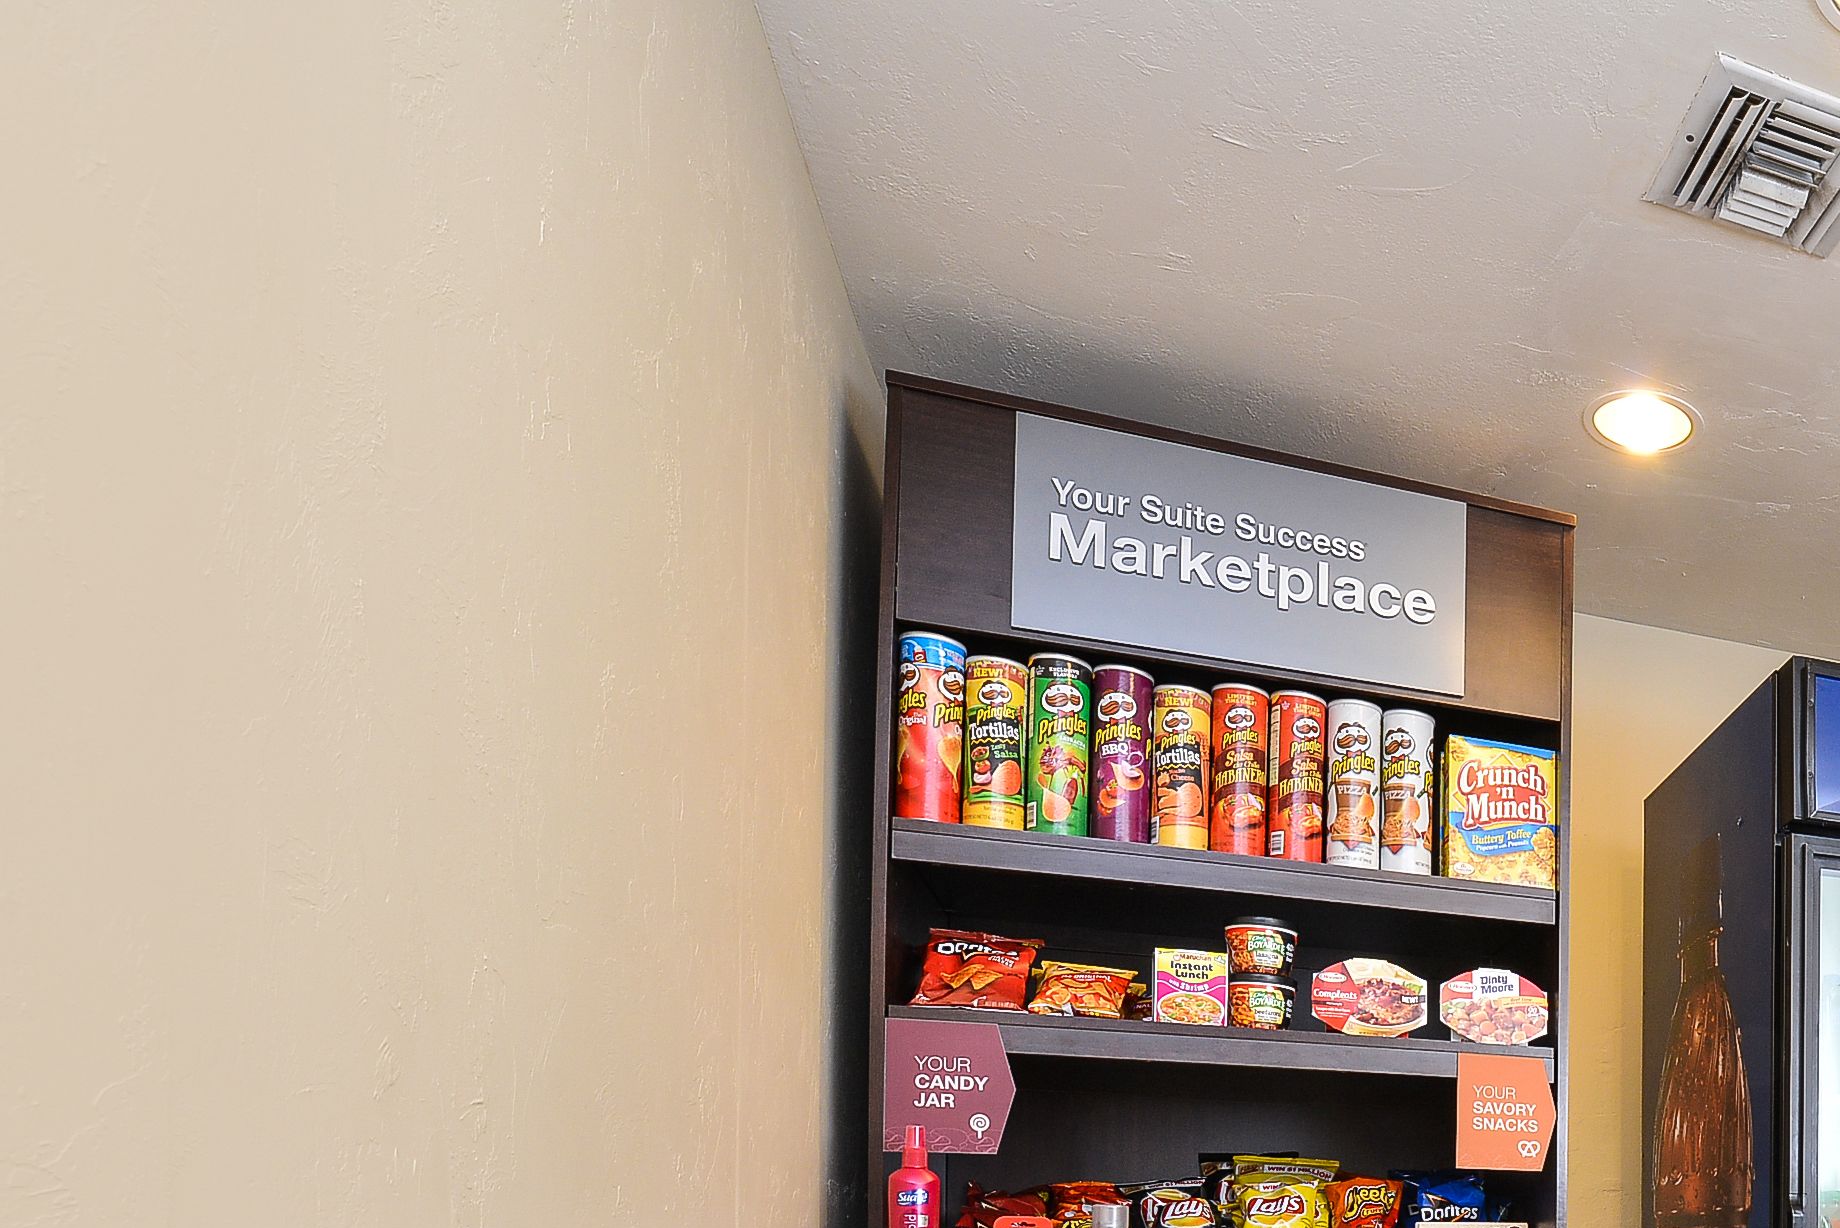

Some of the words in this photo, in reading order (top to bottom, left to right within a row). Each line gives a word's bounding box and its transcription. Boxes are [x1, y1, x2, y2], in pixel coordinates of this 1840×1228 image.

[1051, 477, 1130, 516] Your
[1141, 494, 1226, 535] Suite
[1235, 513, 1366, 562] Success
[1048, 511, 1437, 625] Marketplace
[973, 667, 1003, 678] NEW!
[1164, 697, 1194, 707] NEW!
[976, 704, 1016, 726] Pringles
[970, 720, 1019, 741] Tortillas
[1038, 714, 1087, 743] Pringles
[1095, 719, 1142, 753] Pringles
[1160, 732, 1196, 752] Pringles
[1222, 729, 1258, 749] Pringles
[994, 750, 1018, 759] Salsa
[1101, 742, 1129, 758] BBQ
[1290, 738, 1322, 758] Pringles
[1155, 747, 1200, 767] Tortillas
[1225, 748, 1254, 767] Salsa
[1292, 756, 1318, 776] Salsa
[1331, 751, 1375, 782] Pringles
[1459, 760, 1547, 797] Crunch
[1336, 784, 1367, 795] PIZZA
[1385, 790, 1411, 800] PIZZA
[1466, 792, 1547, 827] Munch
[1471, 833, 1504, 845] Buttery
[1506, 829, 1532, 841] Toffee
[1170, 961, 1213, 972] Instant
[1175, 969, 1209, 980] Lunch
[1480, 975, 1508, 986] Dinty
[1313, 988, 1358, 1001] Compleats
[1481, 984, 1514, 995] Moore
[914, 1055, 971, 1072] YOUR
[914, 1074, 989, 1091] CANDY
[913, 1092, 955, 1108] JAR
[1473, 1085, 1516, 1100] YOUR
[1473, 1101, 1537, 1117] SAVORY
[1473, 1117, 1538, 1132] SNACKS
[1164, 1199, 1211, 1220] Lay's
[1250, 1195, 1300, 1215] Lay's
[1421, 1206, 1478, 1222] Doritos
